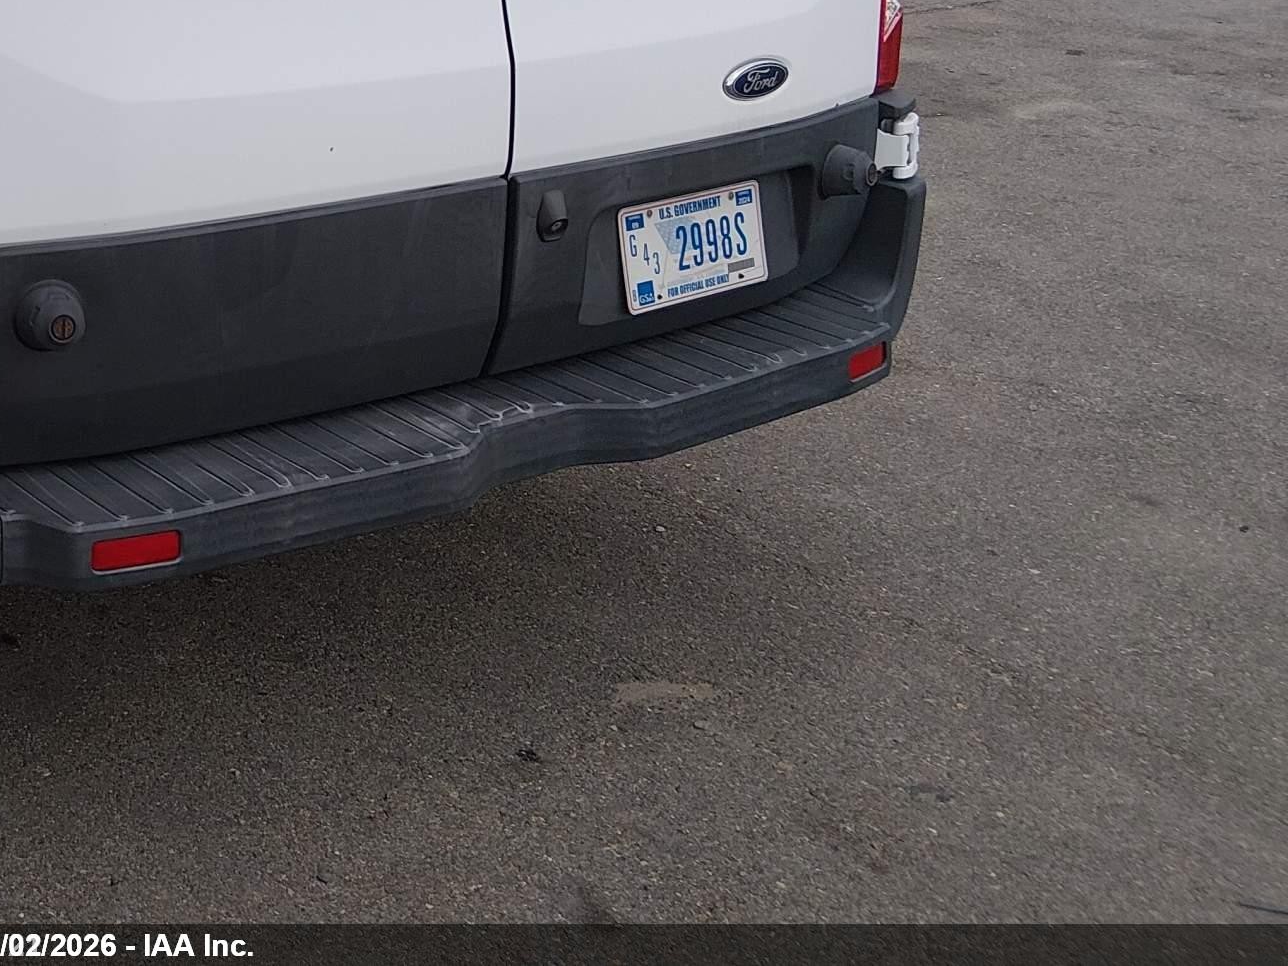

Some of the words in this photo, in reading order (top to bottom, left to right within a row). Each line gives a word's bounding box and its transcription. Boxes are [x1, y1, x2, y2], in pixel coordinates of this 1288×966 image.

[743, 67, 779, 94] Ford
[658, 206, 673, 220] U.S.
[674, 195, 722, 216] GOVERNMENT
[676, 212, 748, 271] 2998S
[667, 287, 679, 298] FOR
[679, 282, 705, 295] OFFICIAL
[705, 278, 717, 289] USE
[716, 273, 730, 285] ONLY
